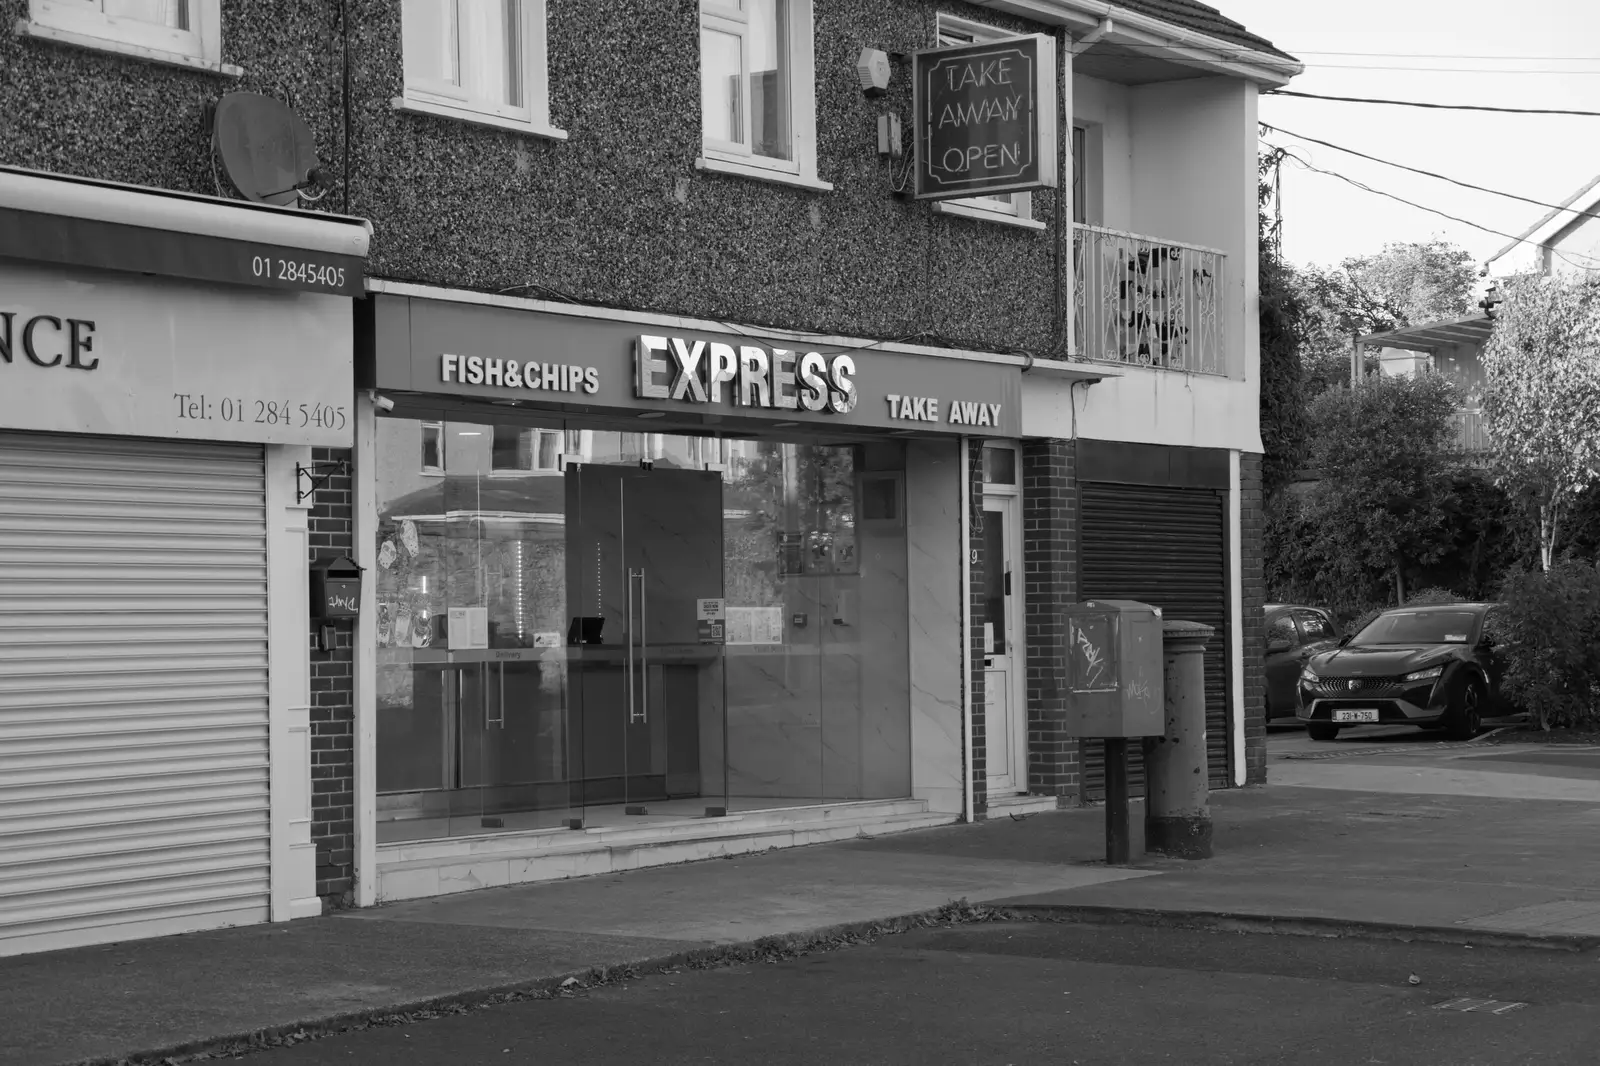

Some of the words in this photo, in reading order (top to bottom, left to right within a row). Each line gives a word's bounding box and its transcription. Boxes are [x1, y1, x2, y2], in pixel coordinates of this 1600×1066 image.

[946, 57, 1012, 91] TAKE
[938, 95, 1022, 129] AWAY
[943, 142, 1020, 172] OPEN
[252, 256, 271, 278] 01
[278, 259, 345, 287] 2845405
[442, 353, 600, 394] FISH&CHIPS
[635, 334, 858, 414] EXPRESS
[173, 393, 212, 420] Tel:
[221, 397, 245, 422] 01
[254, 400, 291, 425] 284
[299, 402, 346, 430] 5405
[887, 394, 938, 422] TAKE
[948, 400, 1001, 427] AWAY
